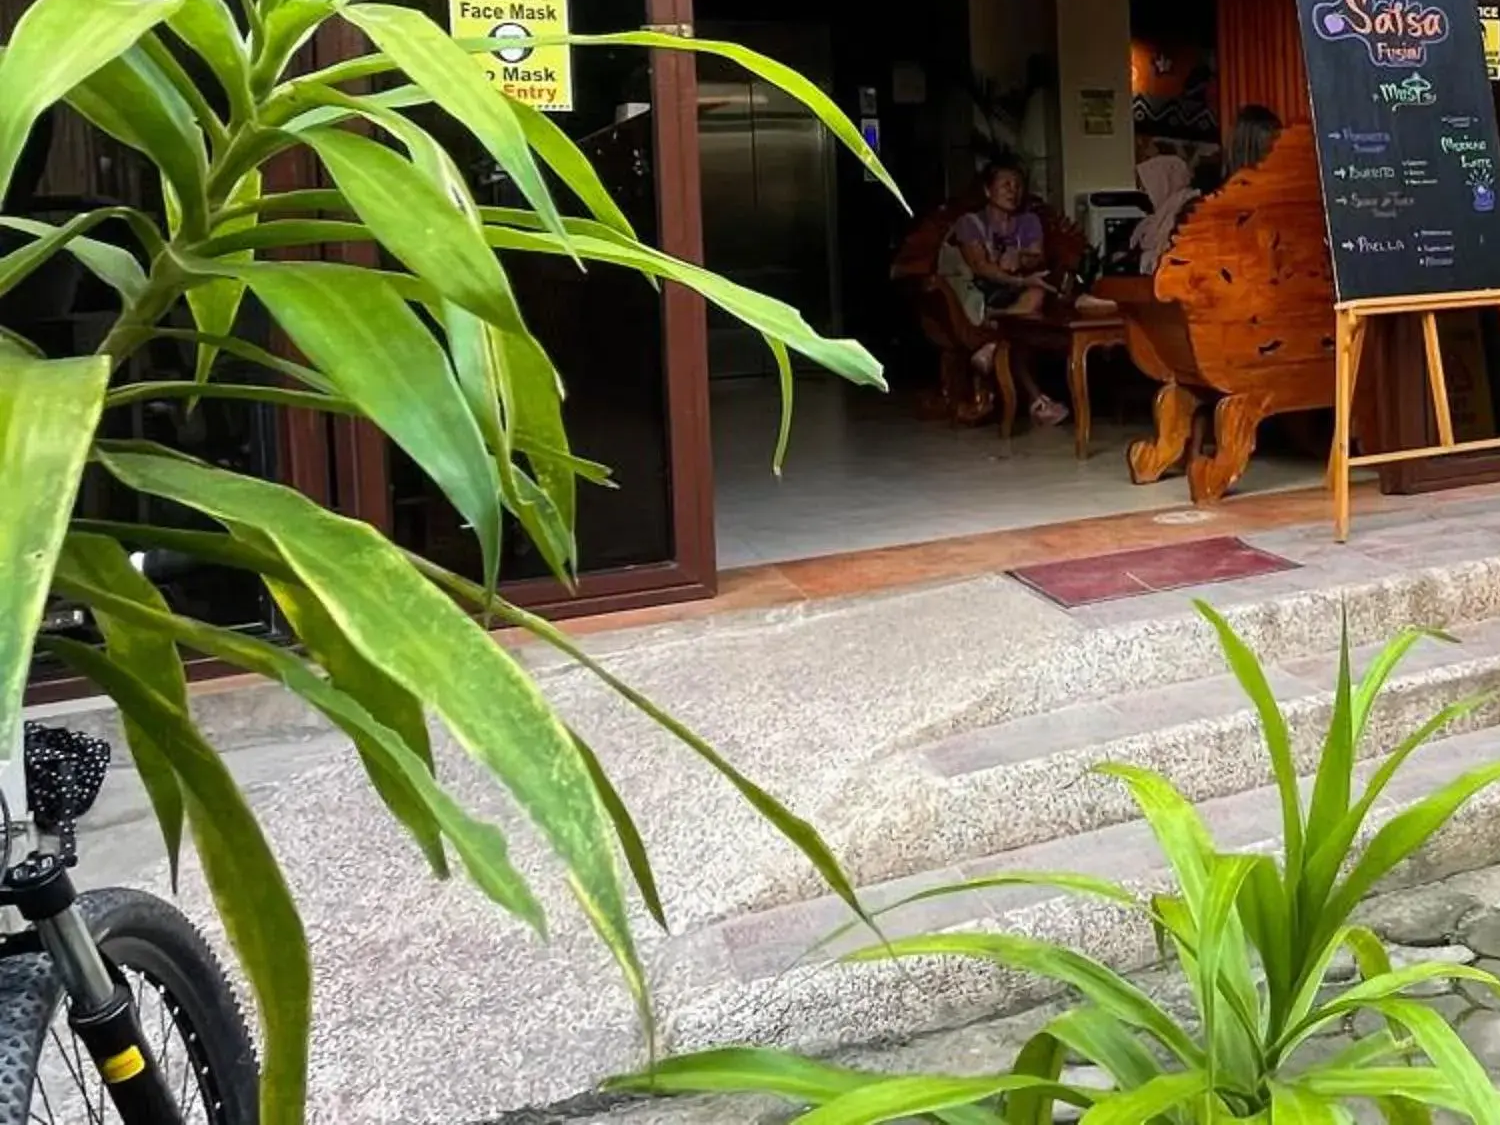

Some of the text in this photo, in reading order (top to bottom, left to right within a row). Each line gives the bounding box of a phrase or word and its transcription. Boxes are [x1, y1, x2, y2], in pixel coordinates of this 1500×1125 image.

[460, 2, 557, 21] Face Mask
[503, 67, 556, 81] Mask
[503, 84, 557, 102] Entry
